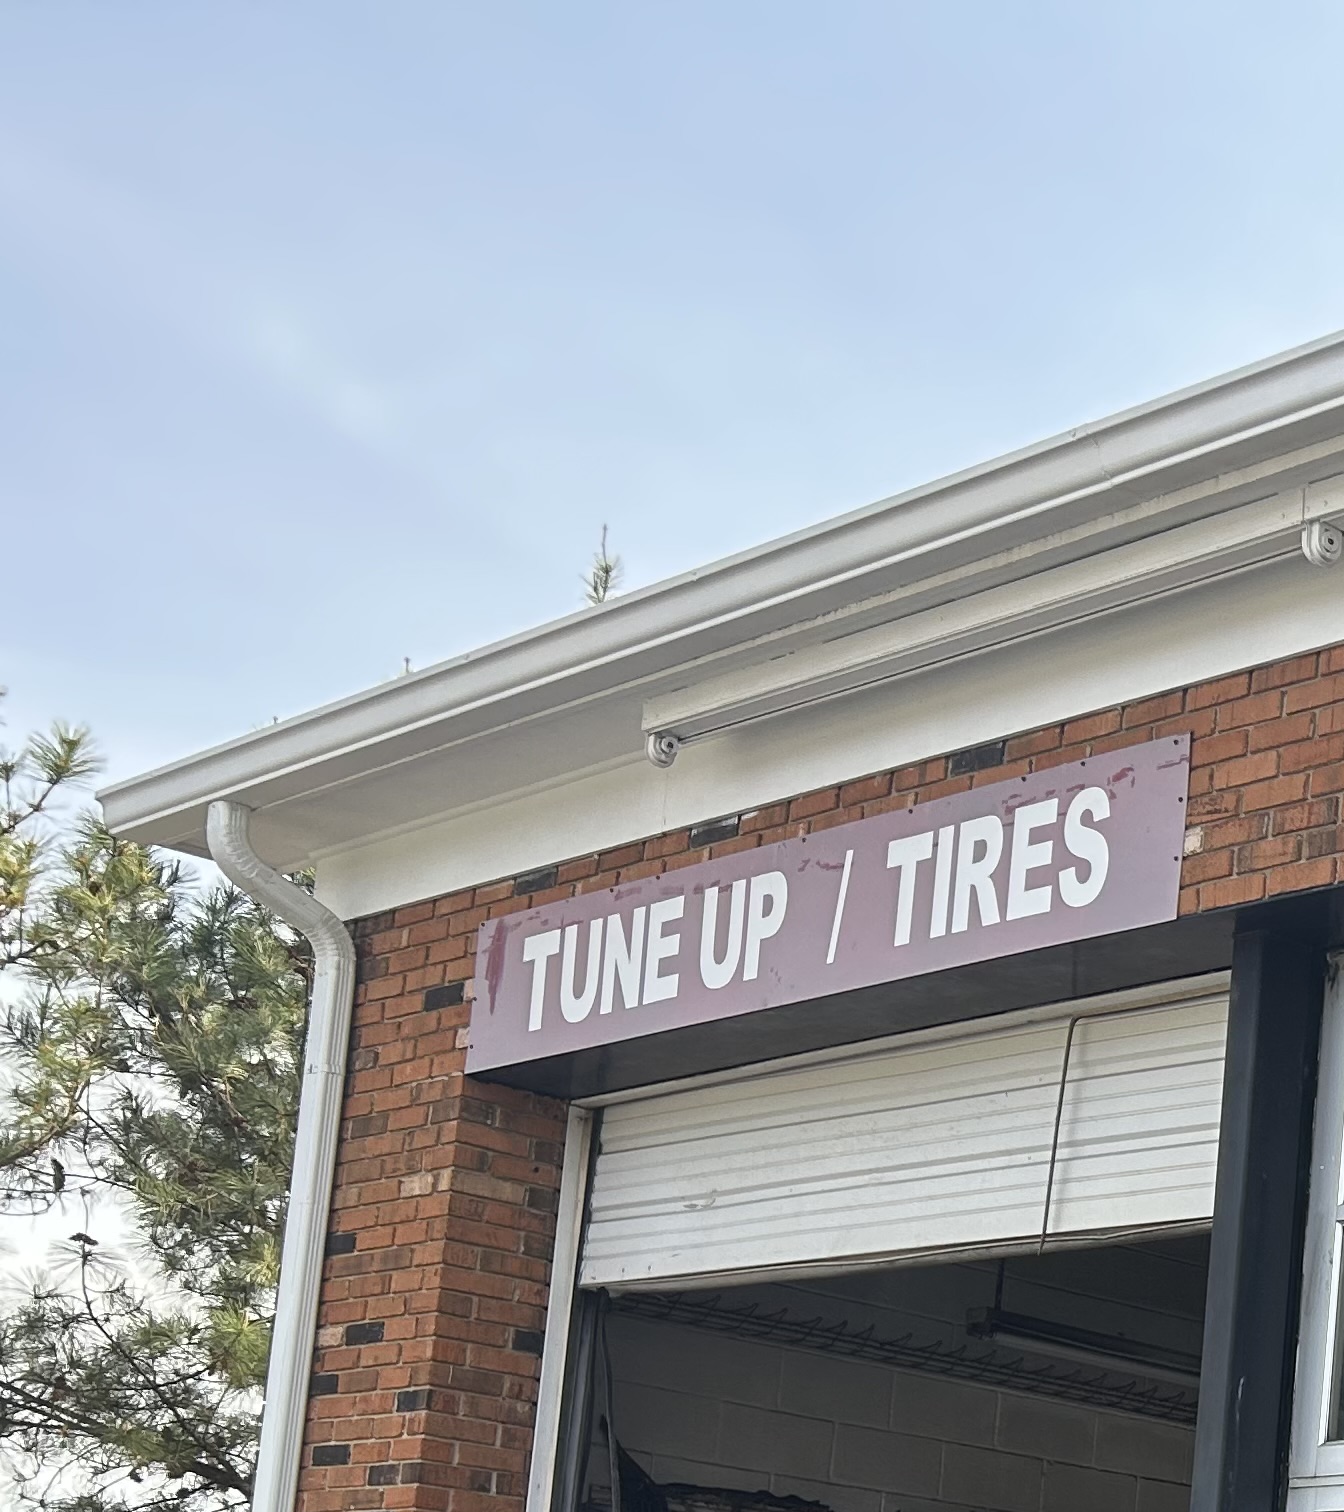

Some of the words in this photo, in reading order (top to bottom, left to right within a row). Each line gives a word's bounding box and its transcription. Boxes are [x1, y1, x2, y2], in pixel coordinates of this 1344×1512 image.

[522, 894, 686, 1033] TUNE
[698, 868, 790, 991] UP
[825, 848, 855, 965] /
[887, 786, 1111, 948] TIRES
